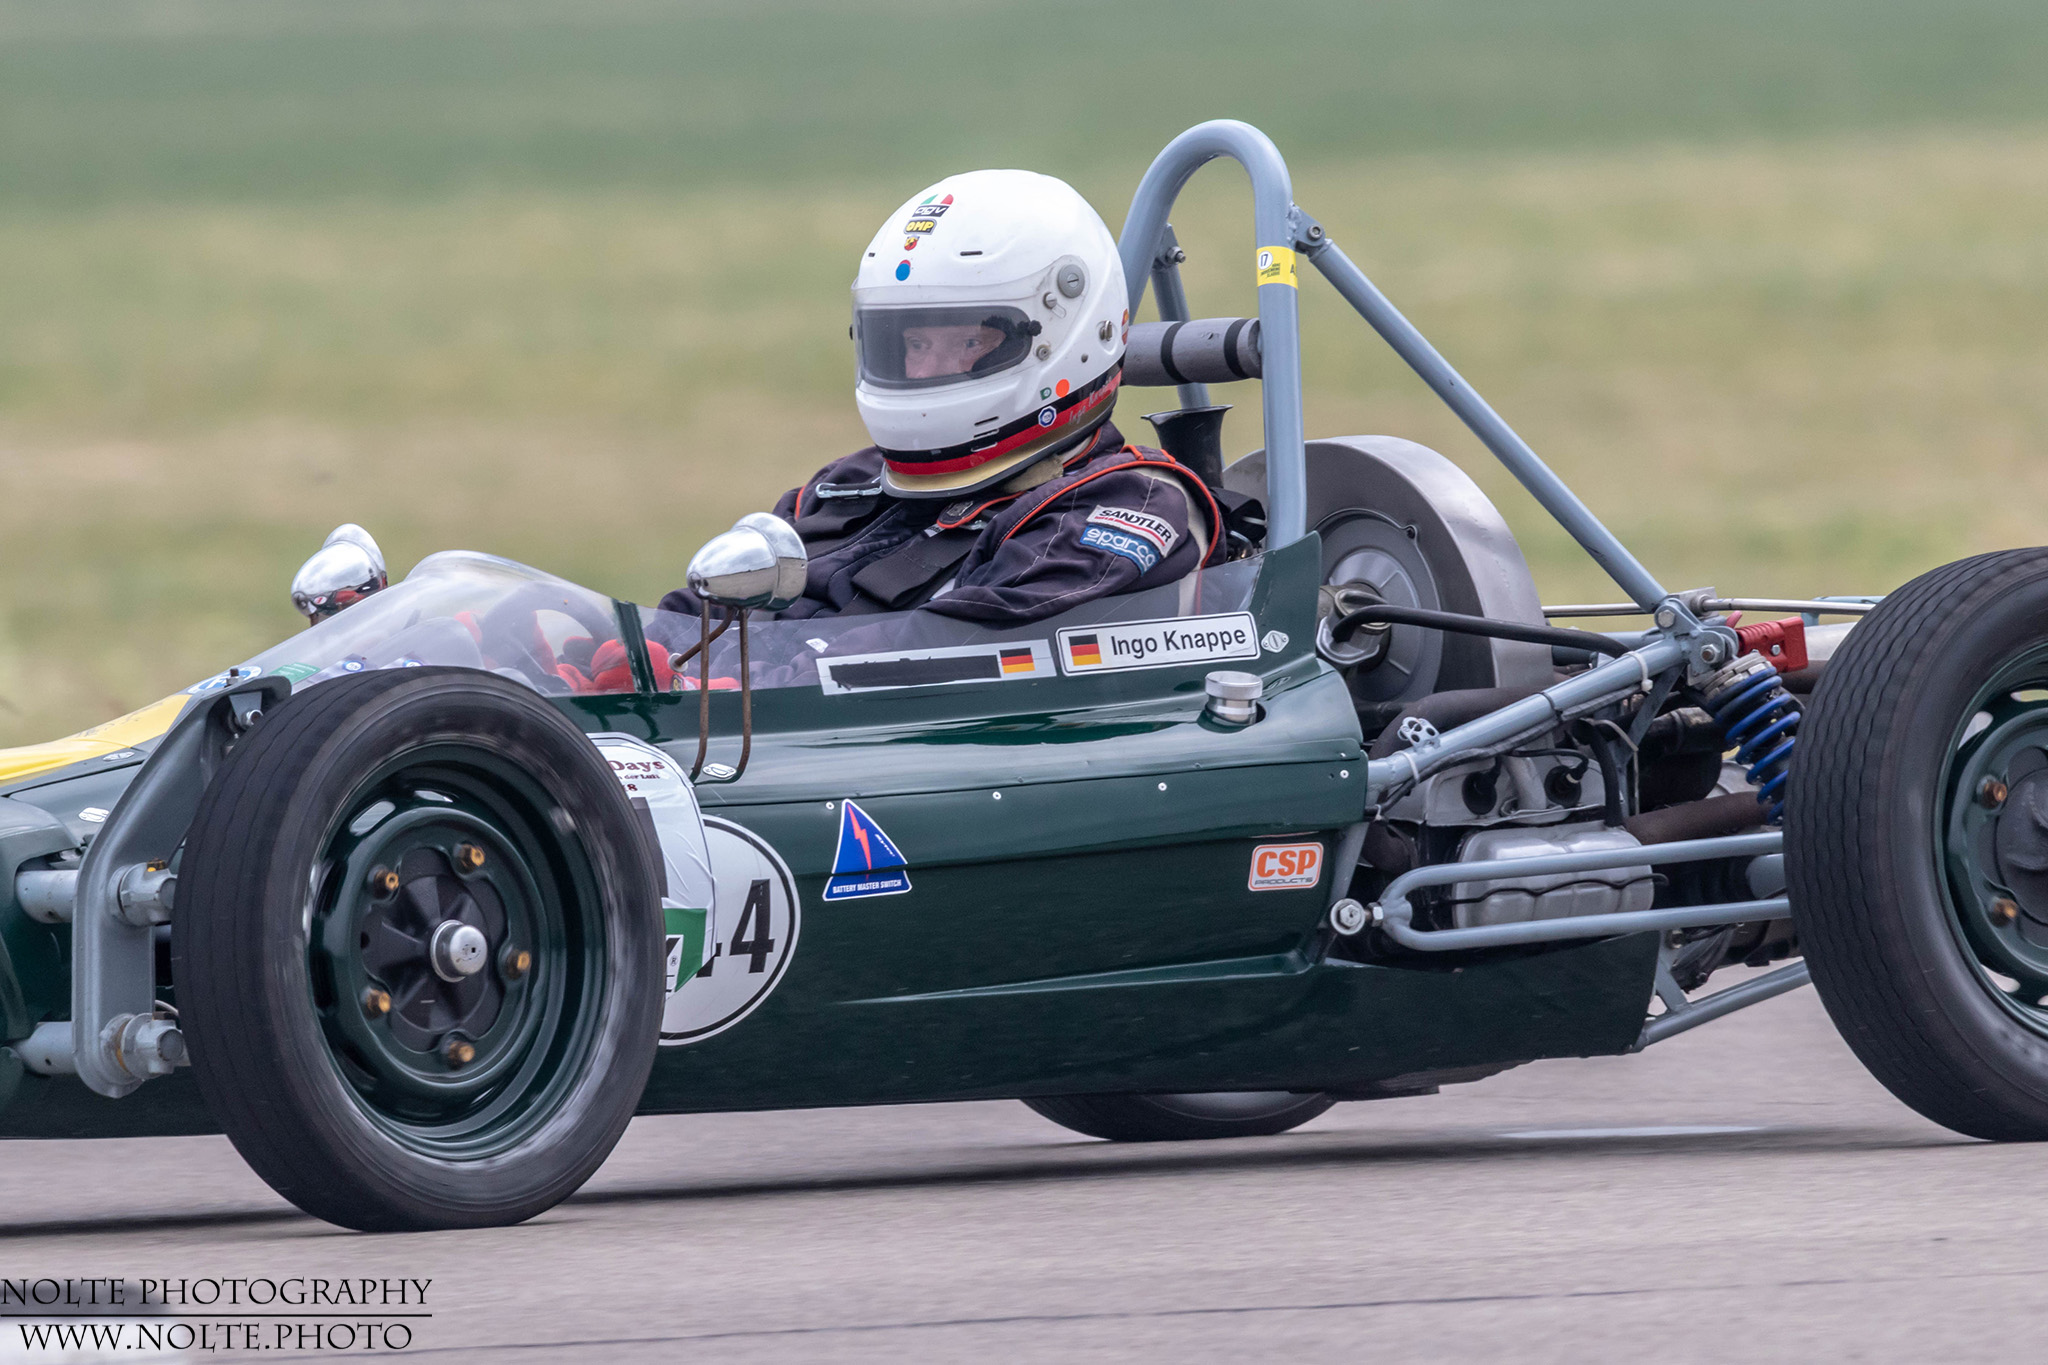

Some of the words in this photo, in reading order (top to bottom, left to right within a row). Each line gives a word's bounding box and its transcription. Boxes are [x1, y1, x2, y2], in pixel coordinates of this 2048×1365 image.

[906, 221, 935, 232] OMP
[1100, 509, 1172, 542] SANDTLER
[1085, 528, 1156, 567] sparco
[1111, 635, 1158, 659] Ingo
[1163, 629, 1247, 652] Knappe
[608, 760, 665, 773] Days
[1256, 849, 1317, 878] CSP
[832, 884, 857, 894] BATTERY
[857, 881, 880, 891] MASTER
[880, 879, 902, 889] SWITCH
[1254, 877, 1314, 886] PRODUCTS
